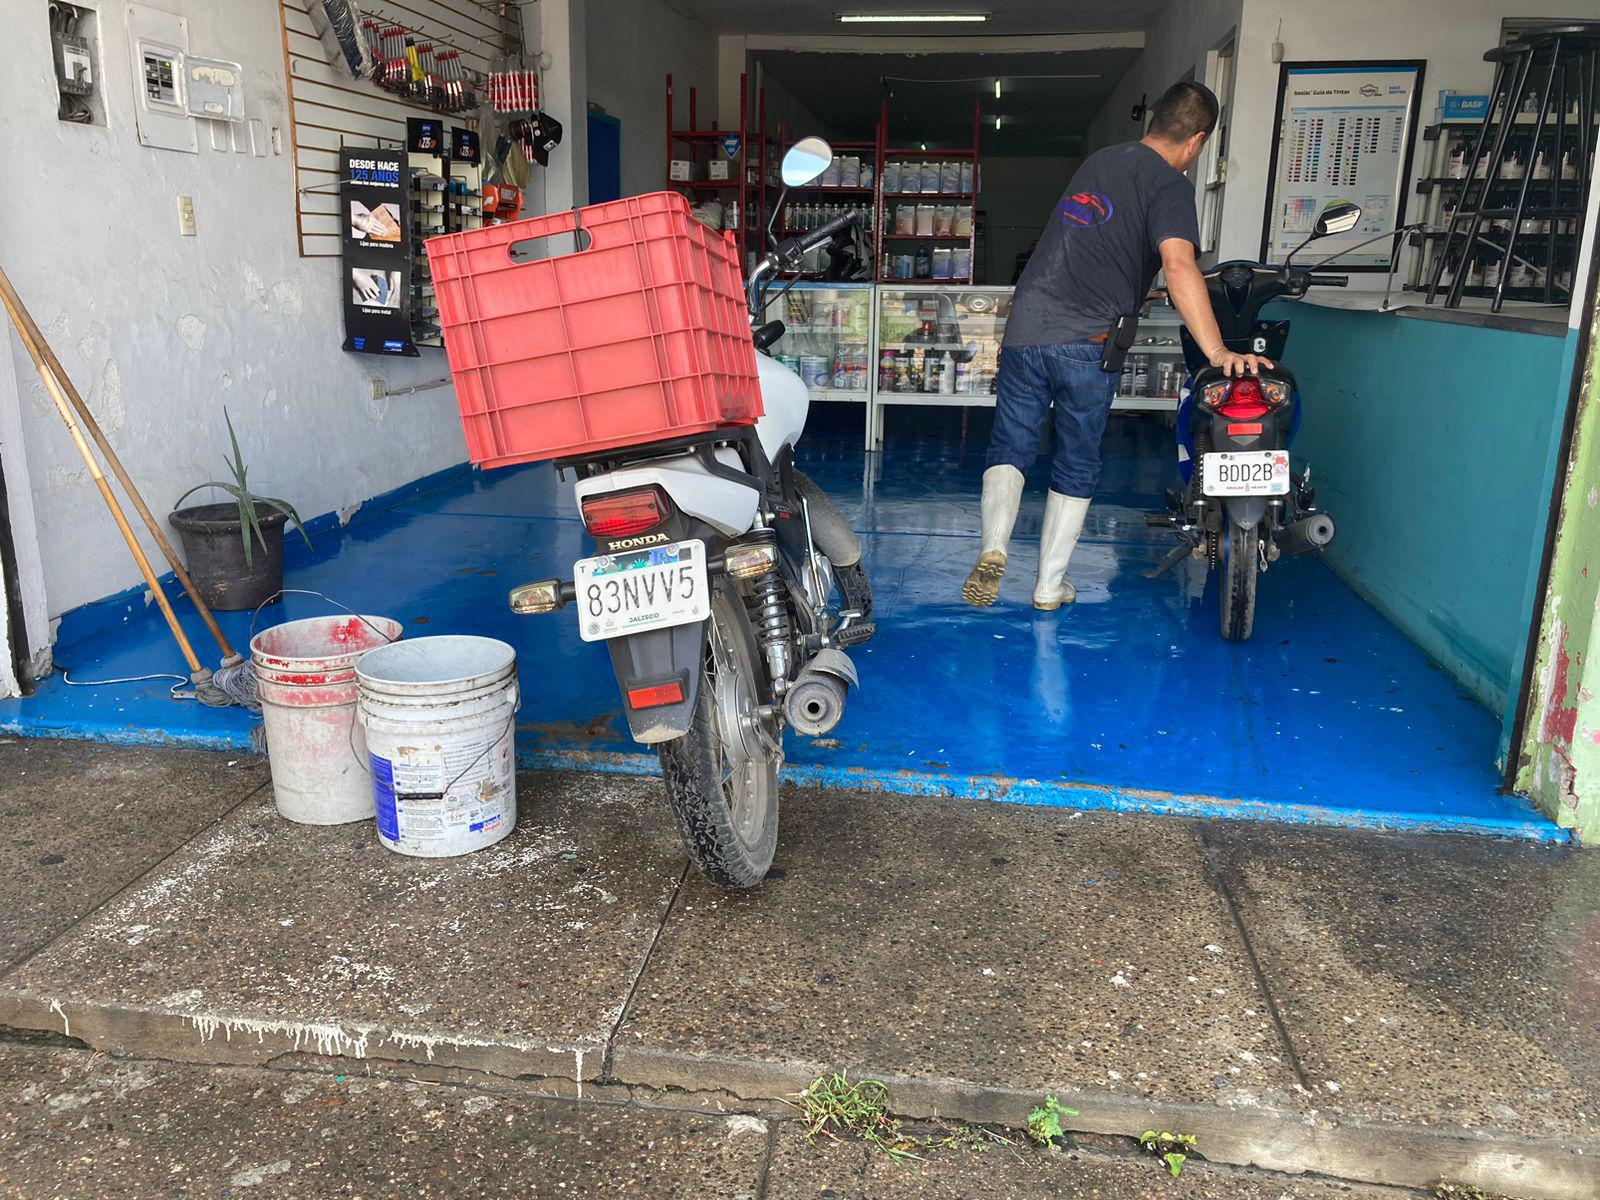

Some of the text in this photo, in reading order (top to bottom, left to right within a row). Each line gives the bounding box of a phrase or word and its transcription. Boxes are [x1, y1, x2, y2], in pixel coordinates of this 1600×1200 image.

[1460, 101, 1484, 109] BASF
[350, 159, 400, 172] DESDE HACE
[351, 169, 368, 180] 125
[1219, 463, 1273, 482] BDD2B
[608, 533, 670, 551] HONDA
[587, 566, 694, 617] 83NVV5
[628, 612, 660, 623] JALISCO
